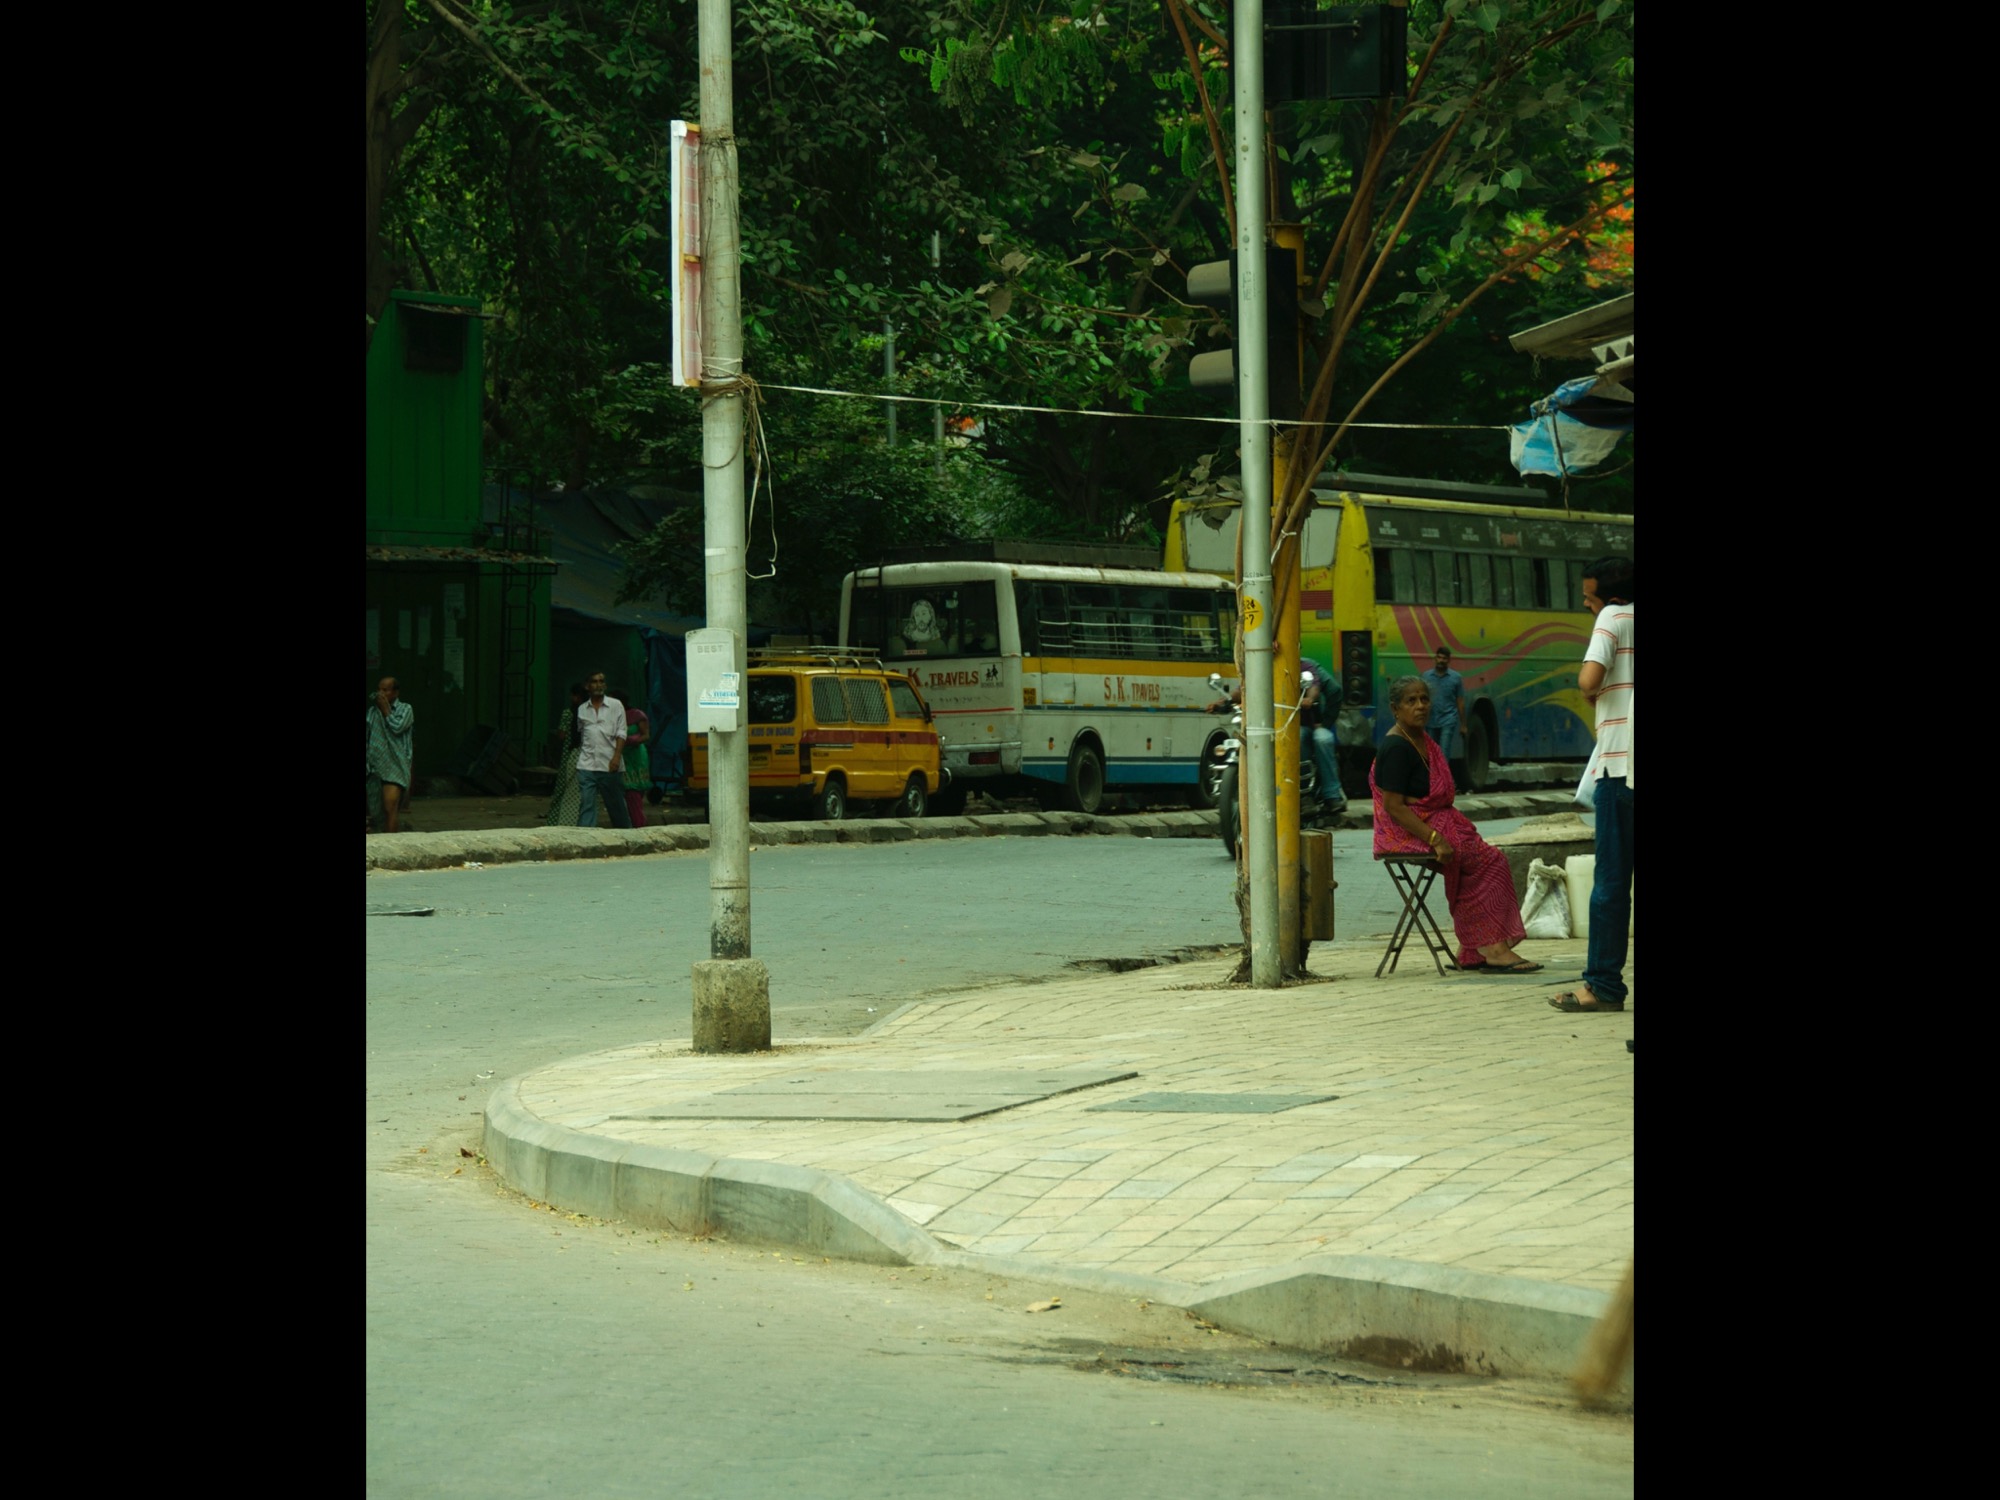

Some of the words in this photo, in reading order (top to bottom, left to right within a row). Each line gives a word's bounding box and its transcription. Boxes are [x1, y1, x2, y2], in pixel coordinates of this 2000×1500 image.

[697, 645, 723, 653] BEST
[929, 671, 979, 687] TRAVELS
[1131, 683, 1160, 702] TRAVELS
